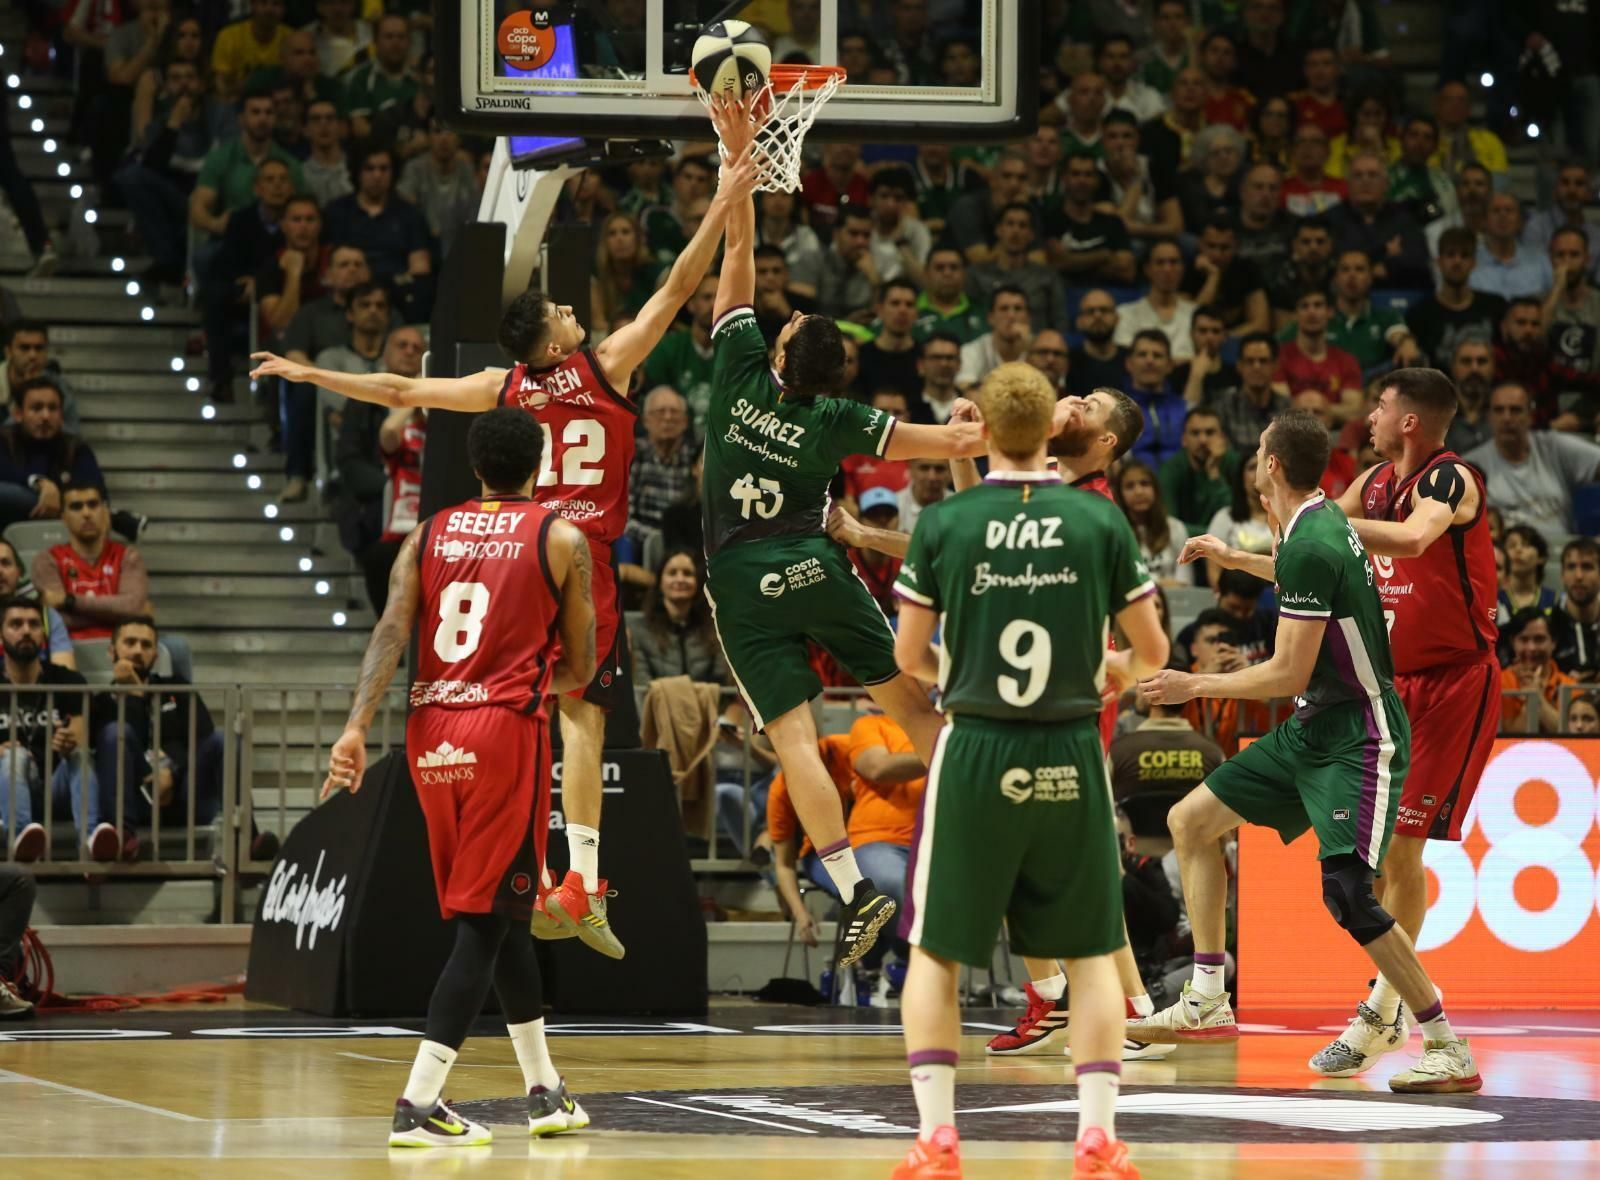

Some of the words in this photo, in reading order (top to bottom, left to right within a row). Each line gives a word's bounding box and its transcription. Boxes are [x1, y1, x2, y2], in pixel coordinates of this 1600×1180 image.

[506, 33, 537, 45] Copa
[520, 44, 541, 57] Rey
[475, 97, 531, 111] SPALDING
[730, 398, 806, 449] SUÁREZ
[446, 511, 526, 537] SEELEY
[985, 512, 1064, 550] DÍAZ
[785, 556, 821, 576] COSTA
[787, 573, 806, 584] DEL
[805, 565, 825, 578] SOL
[433, 581, 491, 663] 8
[997, 618, 1052, 707] 9
[1139, 750, 1203, 768] COFER
[420, 766, 475, 785] SOMMOS
[1035, 766, 1078, 780] COSTA
[1034, 780, 1055, 791] DEL
[1057, 779, 1079, 790] SOL
